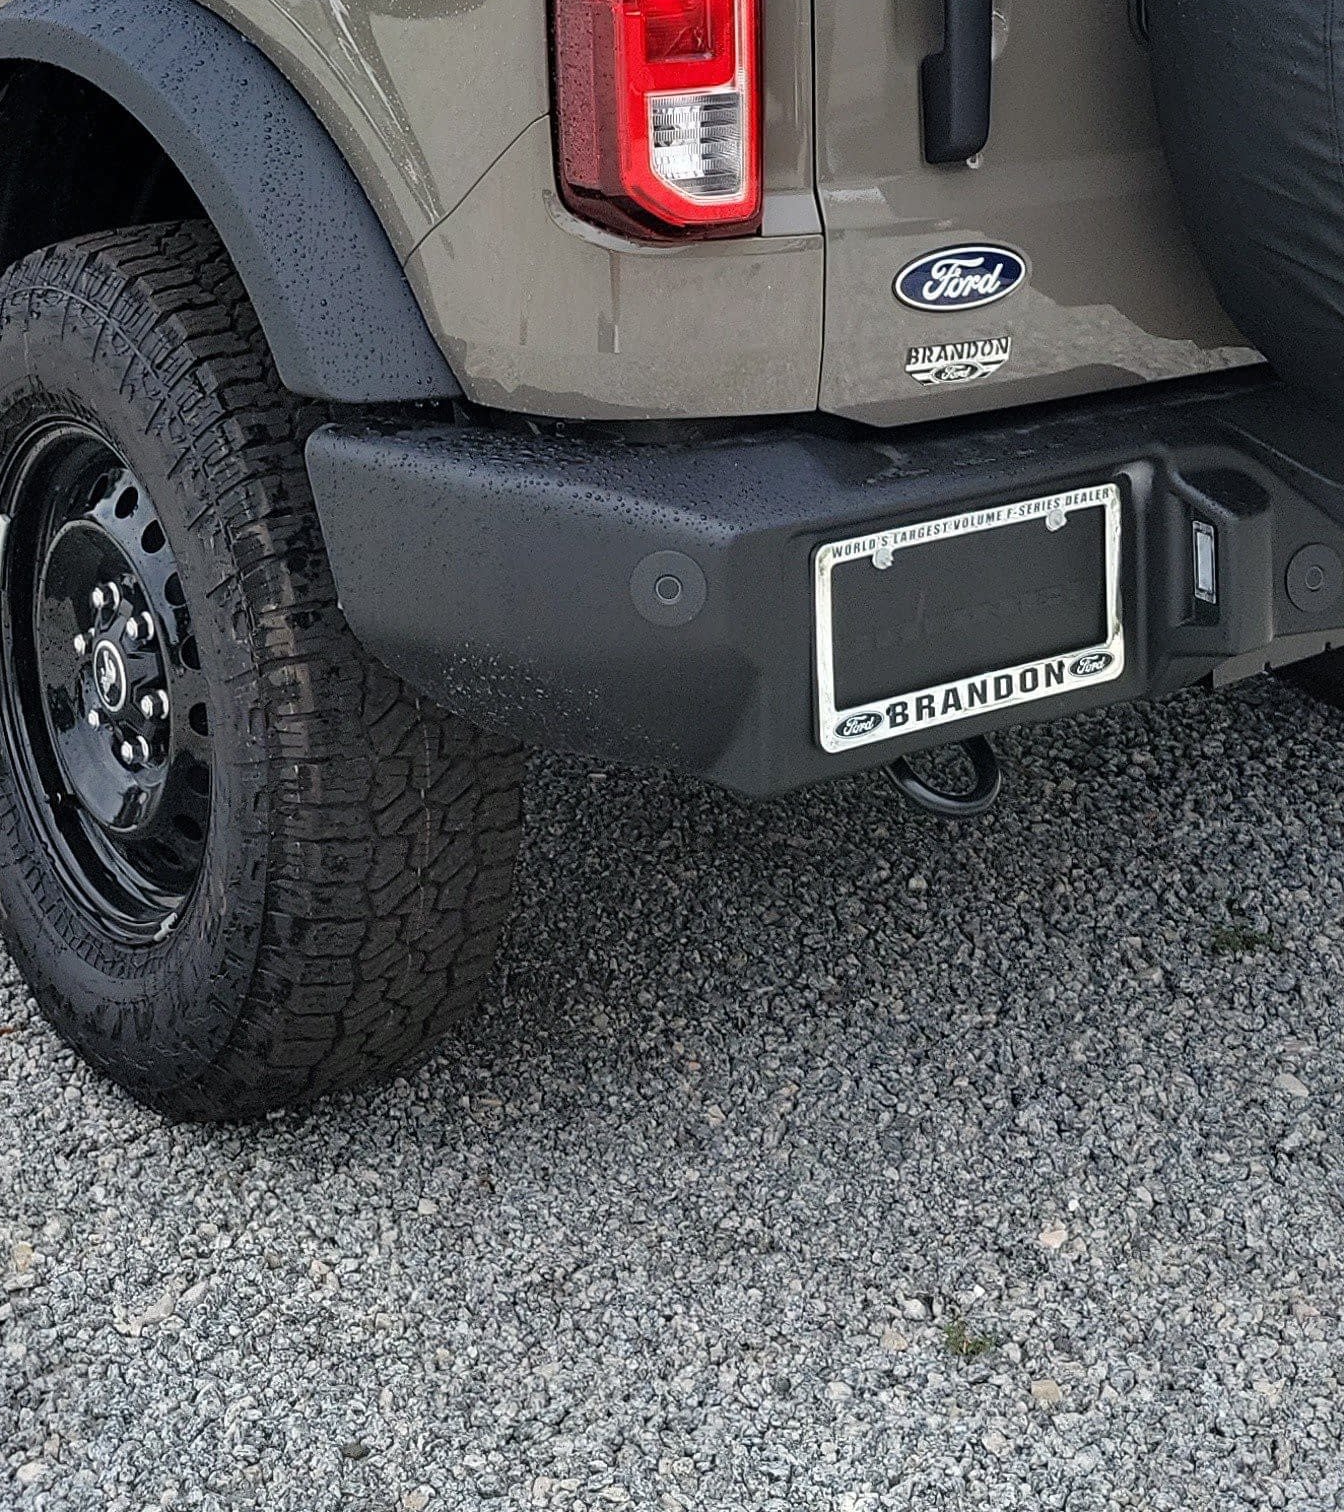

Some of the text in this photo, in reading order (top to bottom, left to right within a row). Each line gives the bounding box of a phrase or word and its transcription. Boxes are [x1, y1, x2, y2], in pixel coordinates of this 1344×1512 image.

[922, 256, 1004, 301] Ford
[907, 337, 1008, 366] BRANDON
[831, 487, 1110, 559] WORLD'S LARGEST VOLUME F-SERIES DEALER
[843, 653, 1107, 736] Ford BRANDON Ford
